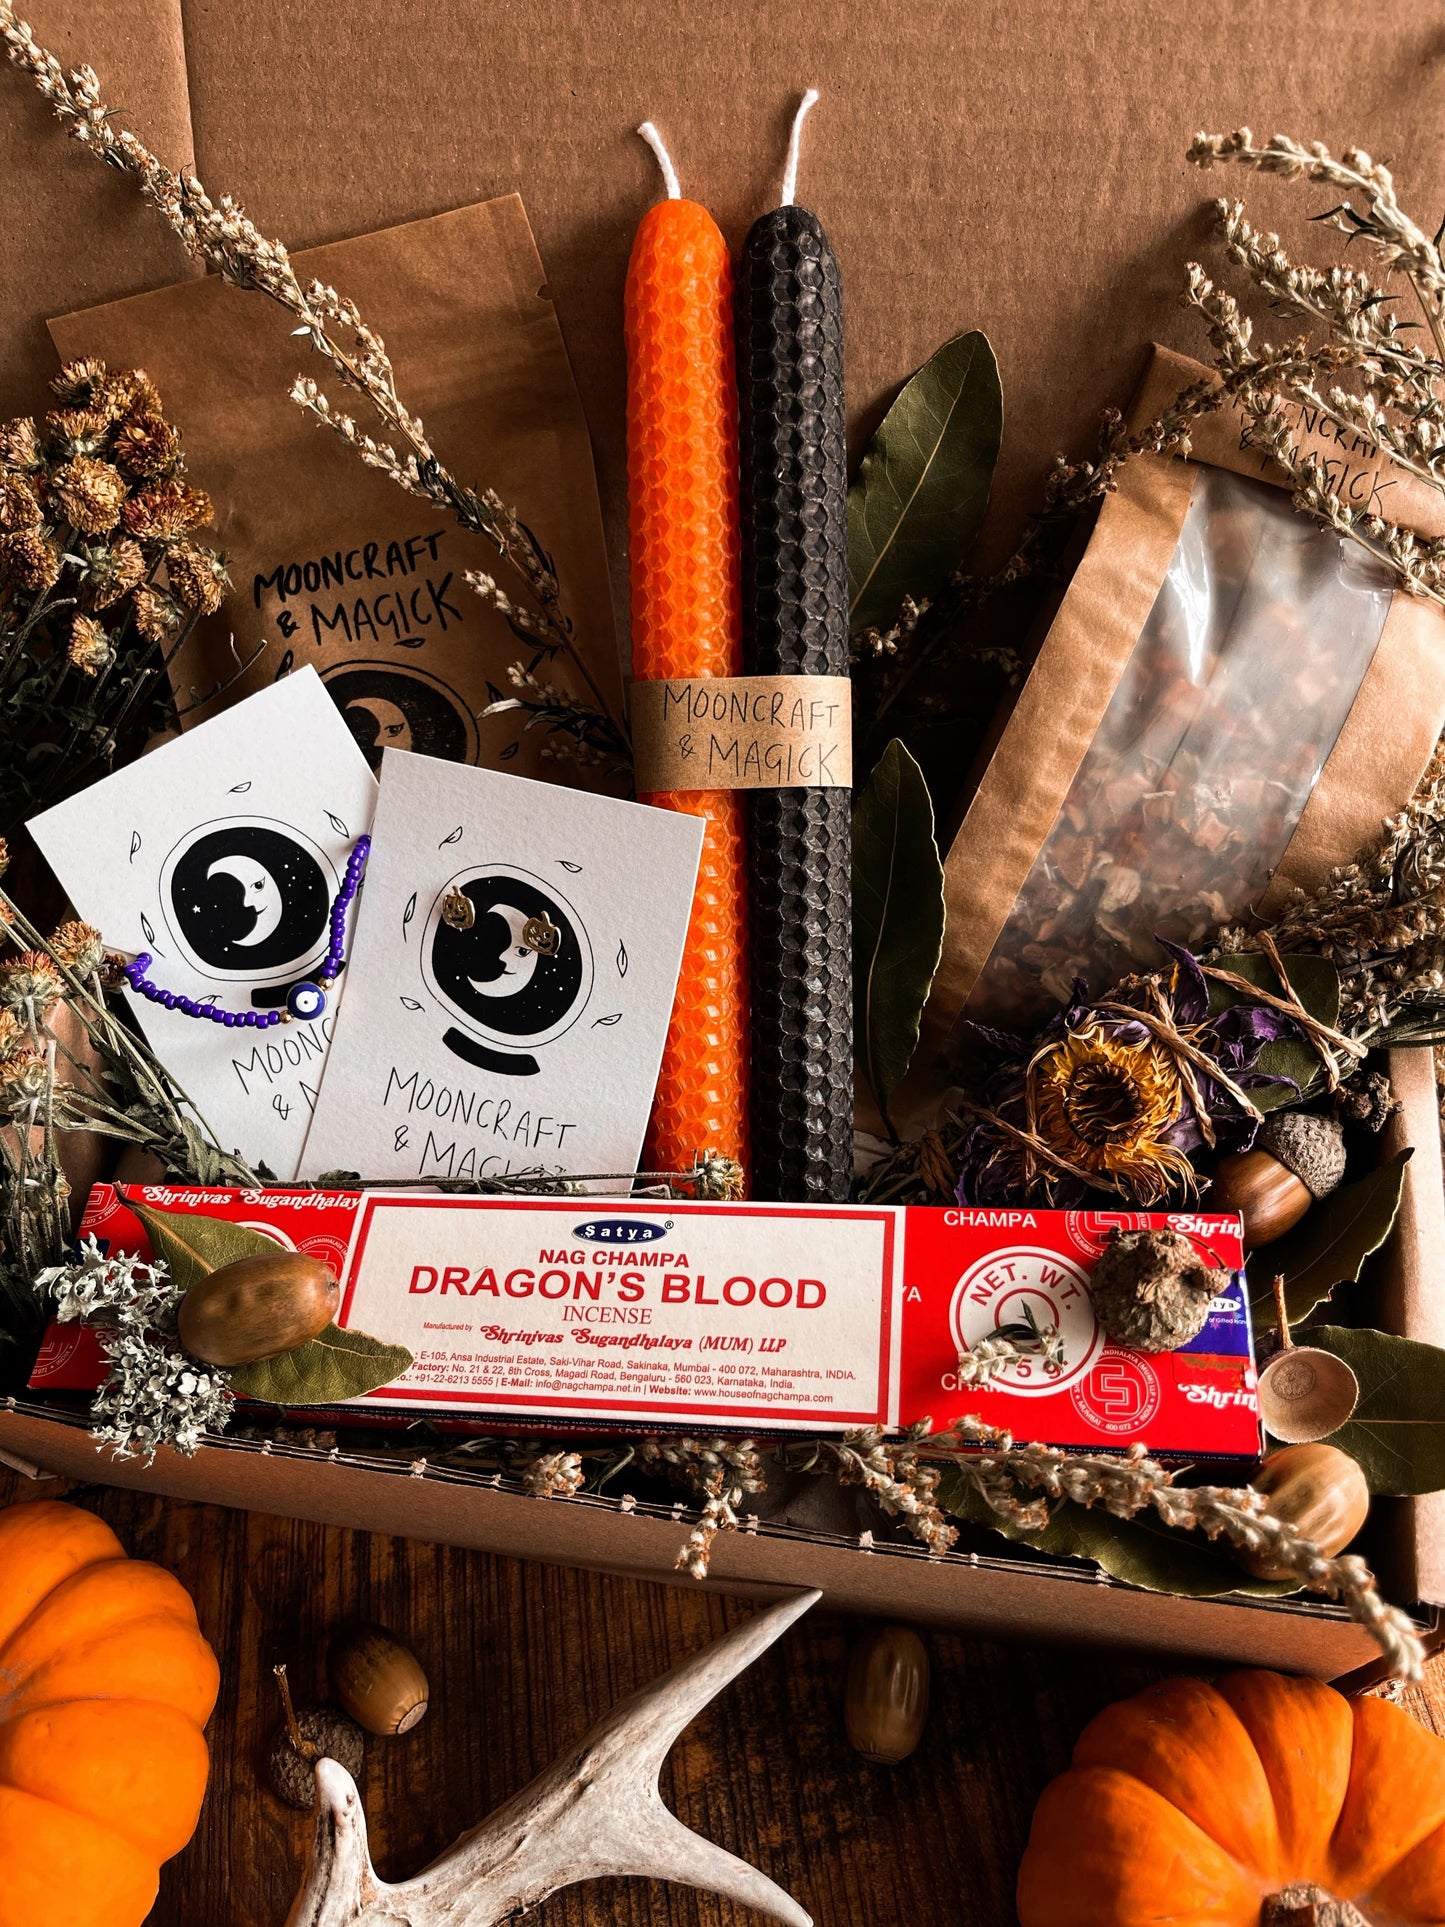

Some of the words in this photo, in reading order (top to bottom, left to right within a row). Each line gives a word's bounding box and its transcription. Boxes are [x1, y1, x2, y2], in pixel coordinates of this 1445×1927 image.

[254, 530, 446, 609] MOONCRAFT
[276, 610, 300, 638] &
[310, 572, 463, 646] MAGICK
[663, 684, 840, 731] MOONCRAFT
[678, 734, 696, 760] &
[708, 733, 838, 787] MAGICK
[272, 1093, 294, 1121] &
[383, 1066, 577, 1149] MOONCRAFT
[394, 1124, 410, 1152] &
[142, 1186, 233, 1207] Shrinivas
[584, 1225, 653, 1240] Satya
[943, 1210, 1038, 1228] CHAMPA
[539, 1249, 586, 1265] NAG
[592, 1250, 690, 1268] CHAMPA
[661, 1274, 827, 1309] BLOOD
[969, 1263, 1028, 1307] NET.
[1038, 1264, 1082, 1311] WT.
[423, 1322, 463, 1331] Manufactured
[465, 1324, 473, 1332] by
[562, 1305, 653, 1324] INCENSE
[480, 1325, 564, 1346] Shrinivas
[570, 1328, 693, 1350] Sugandhalaya
[698, 1335, 754, 1355] (MUM)
[758, 1338, 787, 1353] LLP
[412, 1362, 450, 1373] Factory:
[452, 1364, 467, 1374] No.
[469, 1366, 480, 1374] 21
[482, 1366, 490, 1374] &
[492, 1367, 506, 1376] 22,
[508, 1367, 522, 1376] 8th
[524, 1368, 552, 1379] Cross,
[555, 1369, 588, 1381] Magadi
[590, 1370, 617, 1381] Road,
[620, 1372, 666, 1384] Bengaluru
[674, 1374, 692, 1384] 560
[694, 1375, 714, 1387] 023,
[717, 1377, 767, 1389] Karnataka,
[770, 1379, 796, 1390] India.
[420, 1351, 448, 1361] E-105,
[450, 1352, 473, 1362] Ansa
[475, 1353, 515, 1364] Industrial
[516, 1355, 547, 1366] Estate,
[549, 1356, 595, 1368] Saki-Vihar
[598, 1359, 624, 1370] Road,
[627, 1360, 670, 1372] Sakinaka,
[673, 1362, 710, 1373] Mumbai
[718, 1365, 736, 1374] 400
[738, 1366, 758, 1377] 072,
[761, 1367, 822, 1380] Maharashtra,
[825, 1370, 857, 1381] INDIA.
[414, 1374, 470, 1385] +91-22-6213
[471, 1376, 494, 1386] 5555
[501, 1378, 533, 1388] E-Mail:
[535, 1379, 641, 1393] info@nagchampa.net.in
[649, 1385, 691, 1396] Website:
[694, 1388, 833, 1404] www.houseofnagchampa.com
